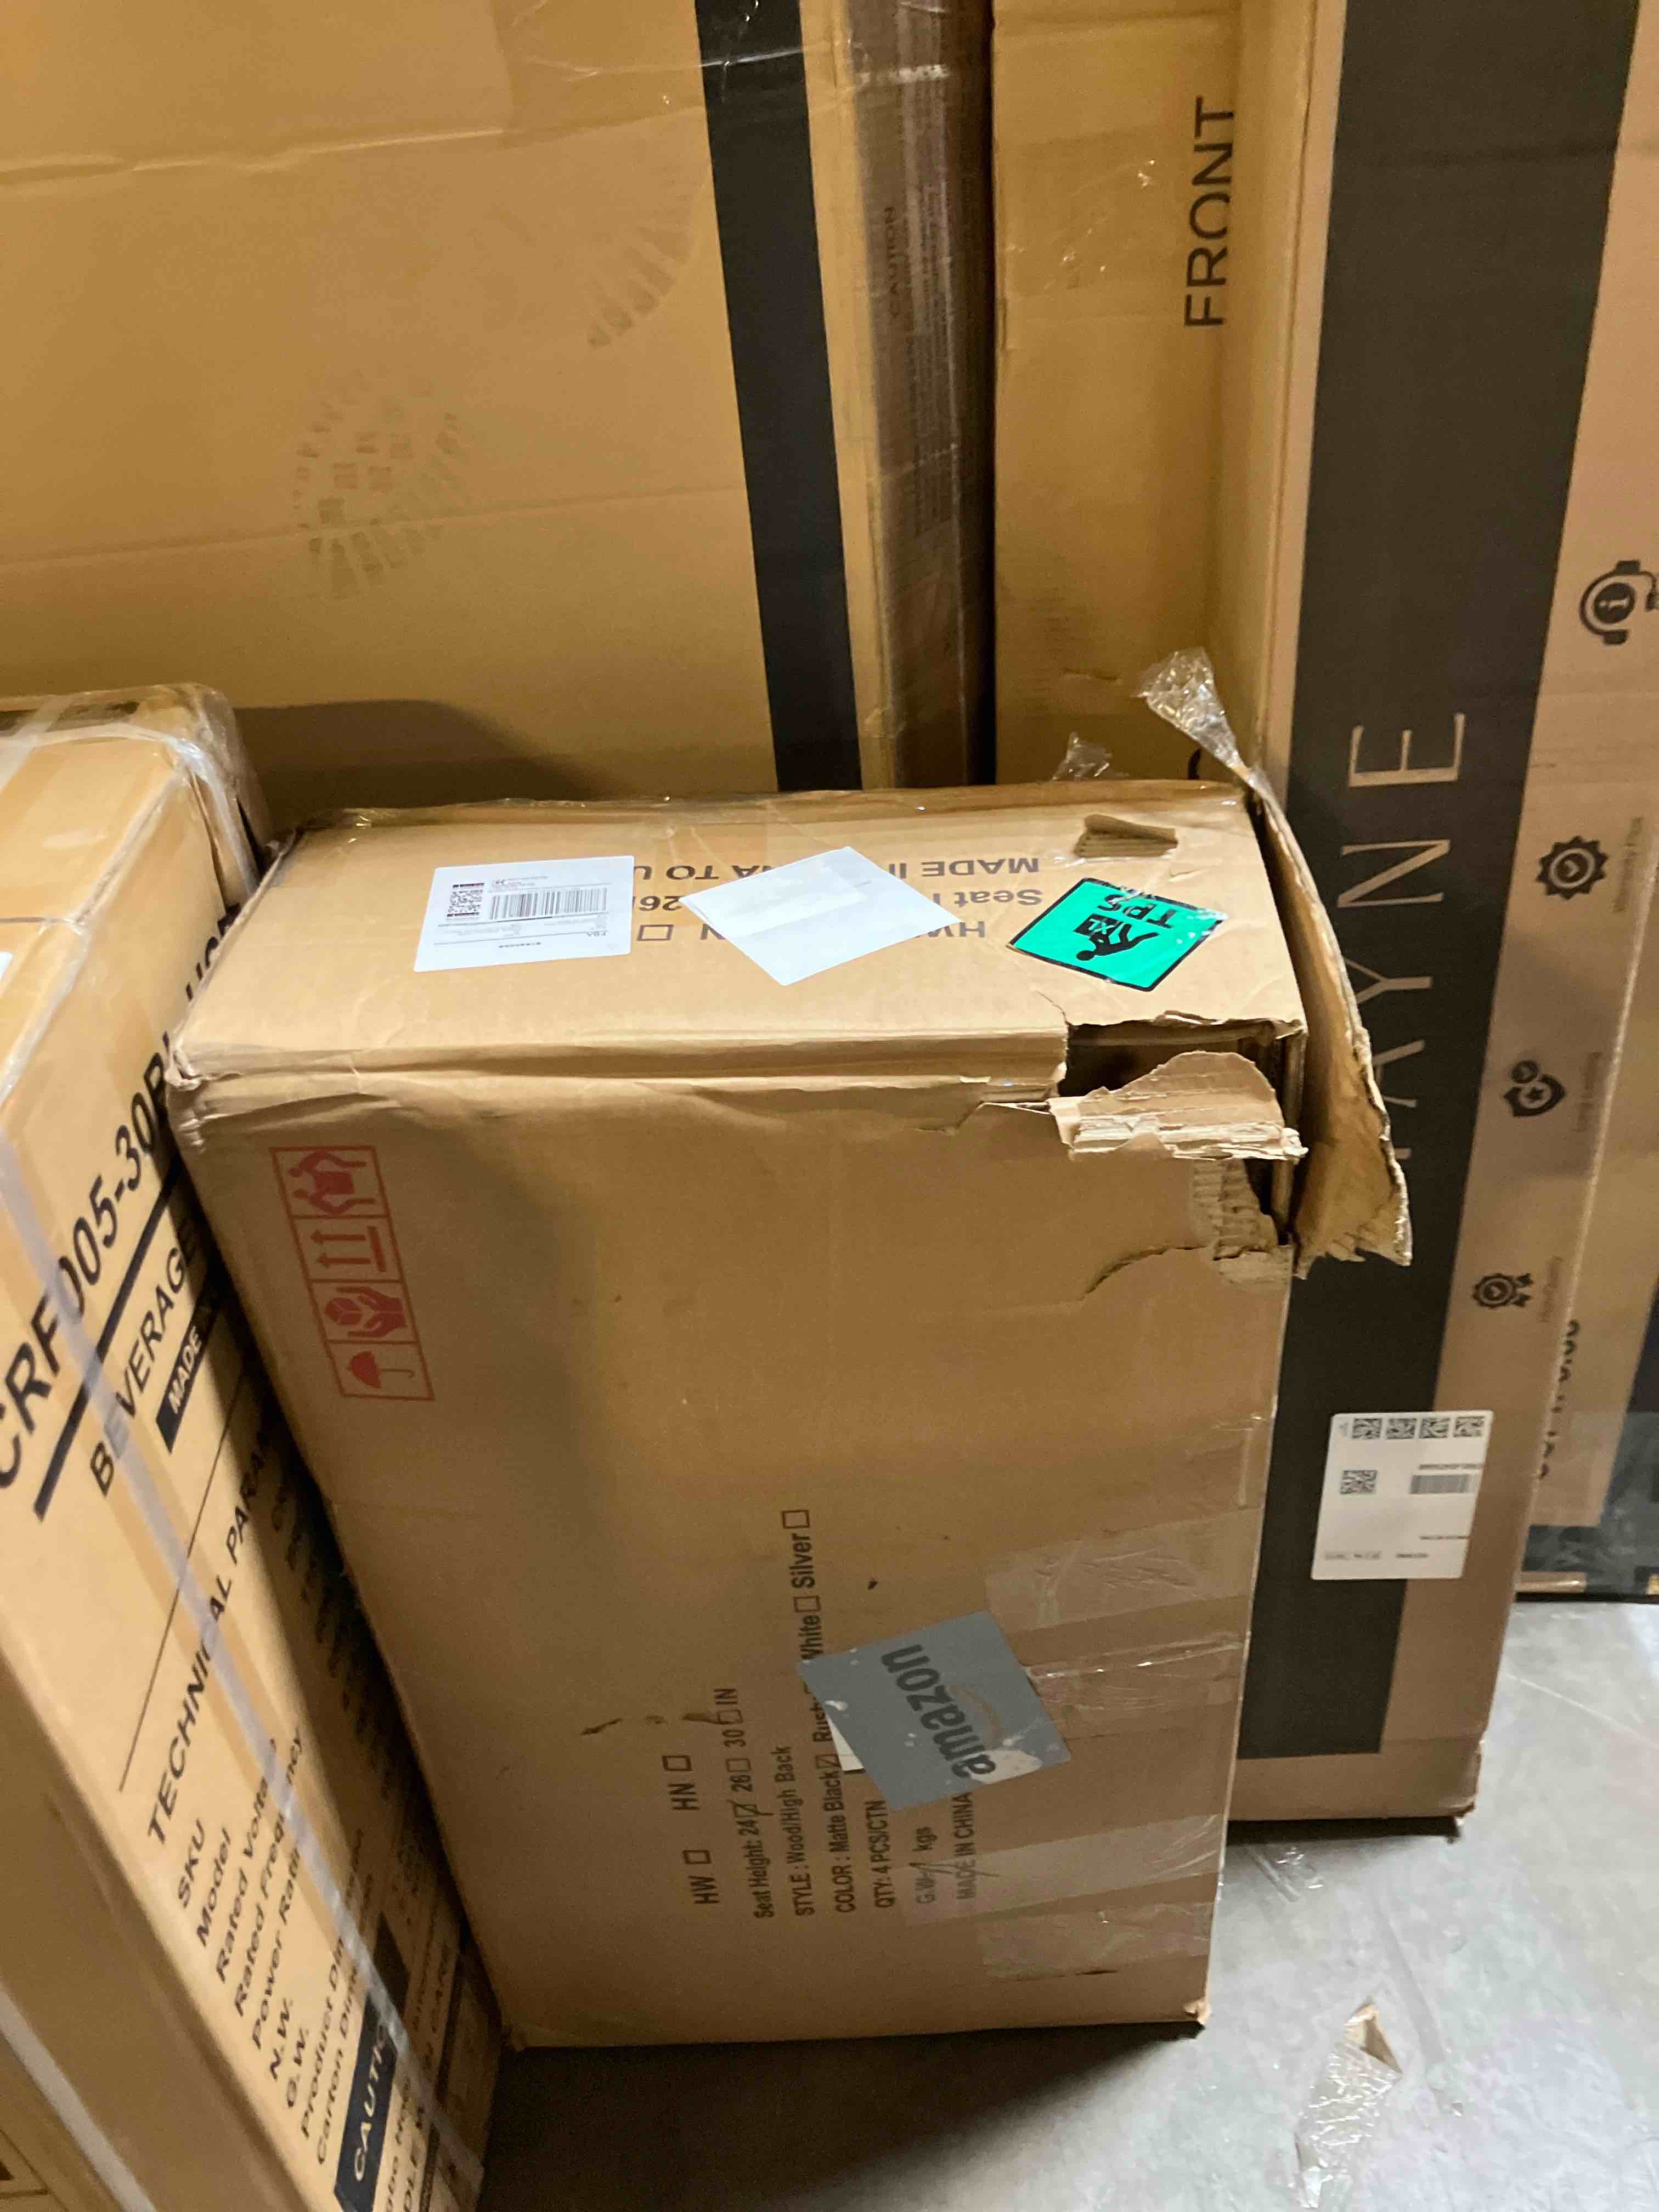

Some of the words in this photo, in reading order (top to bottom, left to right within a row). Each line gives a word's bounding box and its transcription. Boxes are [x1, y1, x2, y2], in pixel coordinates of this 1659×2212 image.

[1184, 95, 1234, 327] FRONT
[665, 865, 719, 880] TO
[921, 857, 1040, 877] MADE
[953, 889, 1043, 908] Seat
[1097, 894, 1177, 929] TPS
[1338, 713, 1466, 1159] AYNE
[788, 1532, 816, 1589] Silver
[714, 1688, 738, 1706] IN
[881, 1644, 996, 1779] amazon
[722, 1729, 747, 1747] 30
[770, 1746, 797, 1783] Back
[667, 1782, 701, 1810] HN
[820, 1769, 845, 1811] Black
[737, 1820, 760, 1836] 24
[827, 1814, 850, 1853] Matte
[865, 1799, 891, 1863] PCS/CTN
[951, 1791, 975, 1839] CHINA
[912, 1826, 938, 1852] kgs
[953, 1842, 977, 1857] IN
[177, 1819, 205, 1909] SKU
[744, 1839, 771, 1888] Height:
[871, 1865, 891, 1874] 4
[956, 1859, 976, 1900] MADE
[196, 1828, 232, 1948] Model
[688, 1875, 720, 1905] HW
[753, 1891, 775, 1919] Seat
[873, 1876, 897, 1909] QTY:
[216, 1867, 249, 1984] Rated
[233, 1903, 265, 2018] Rated
[251, 1929, 284, 2050] Power
[301, 1996, 333, 2140] Product
[354, 2024, 387, 2182] CAUTIO
